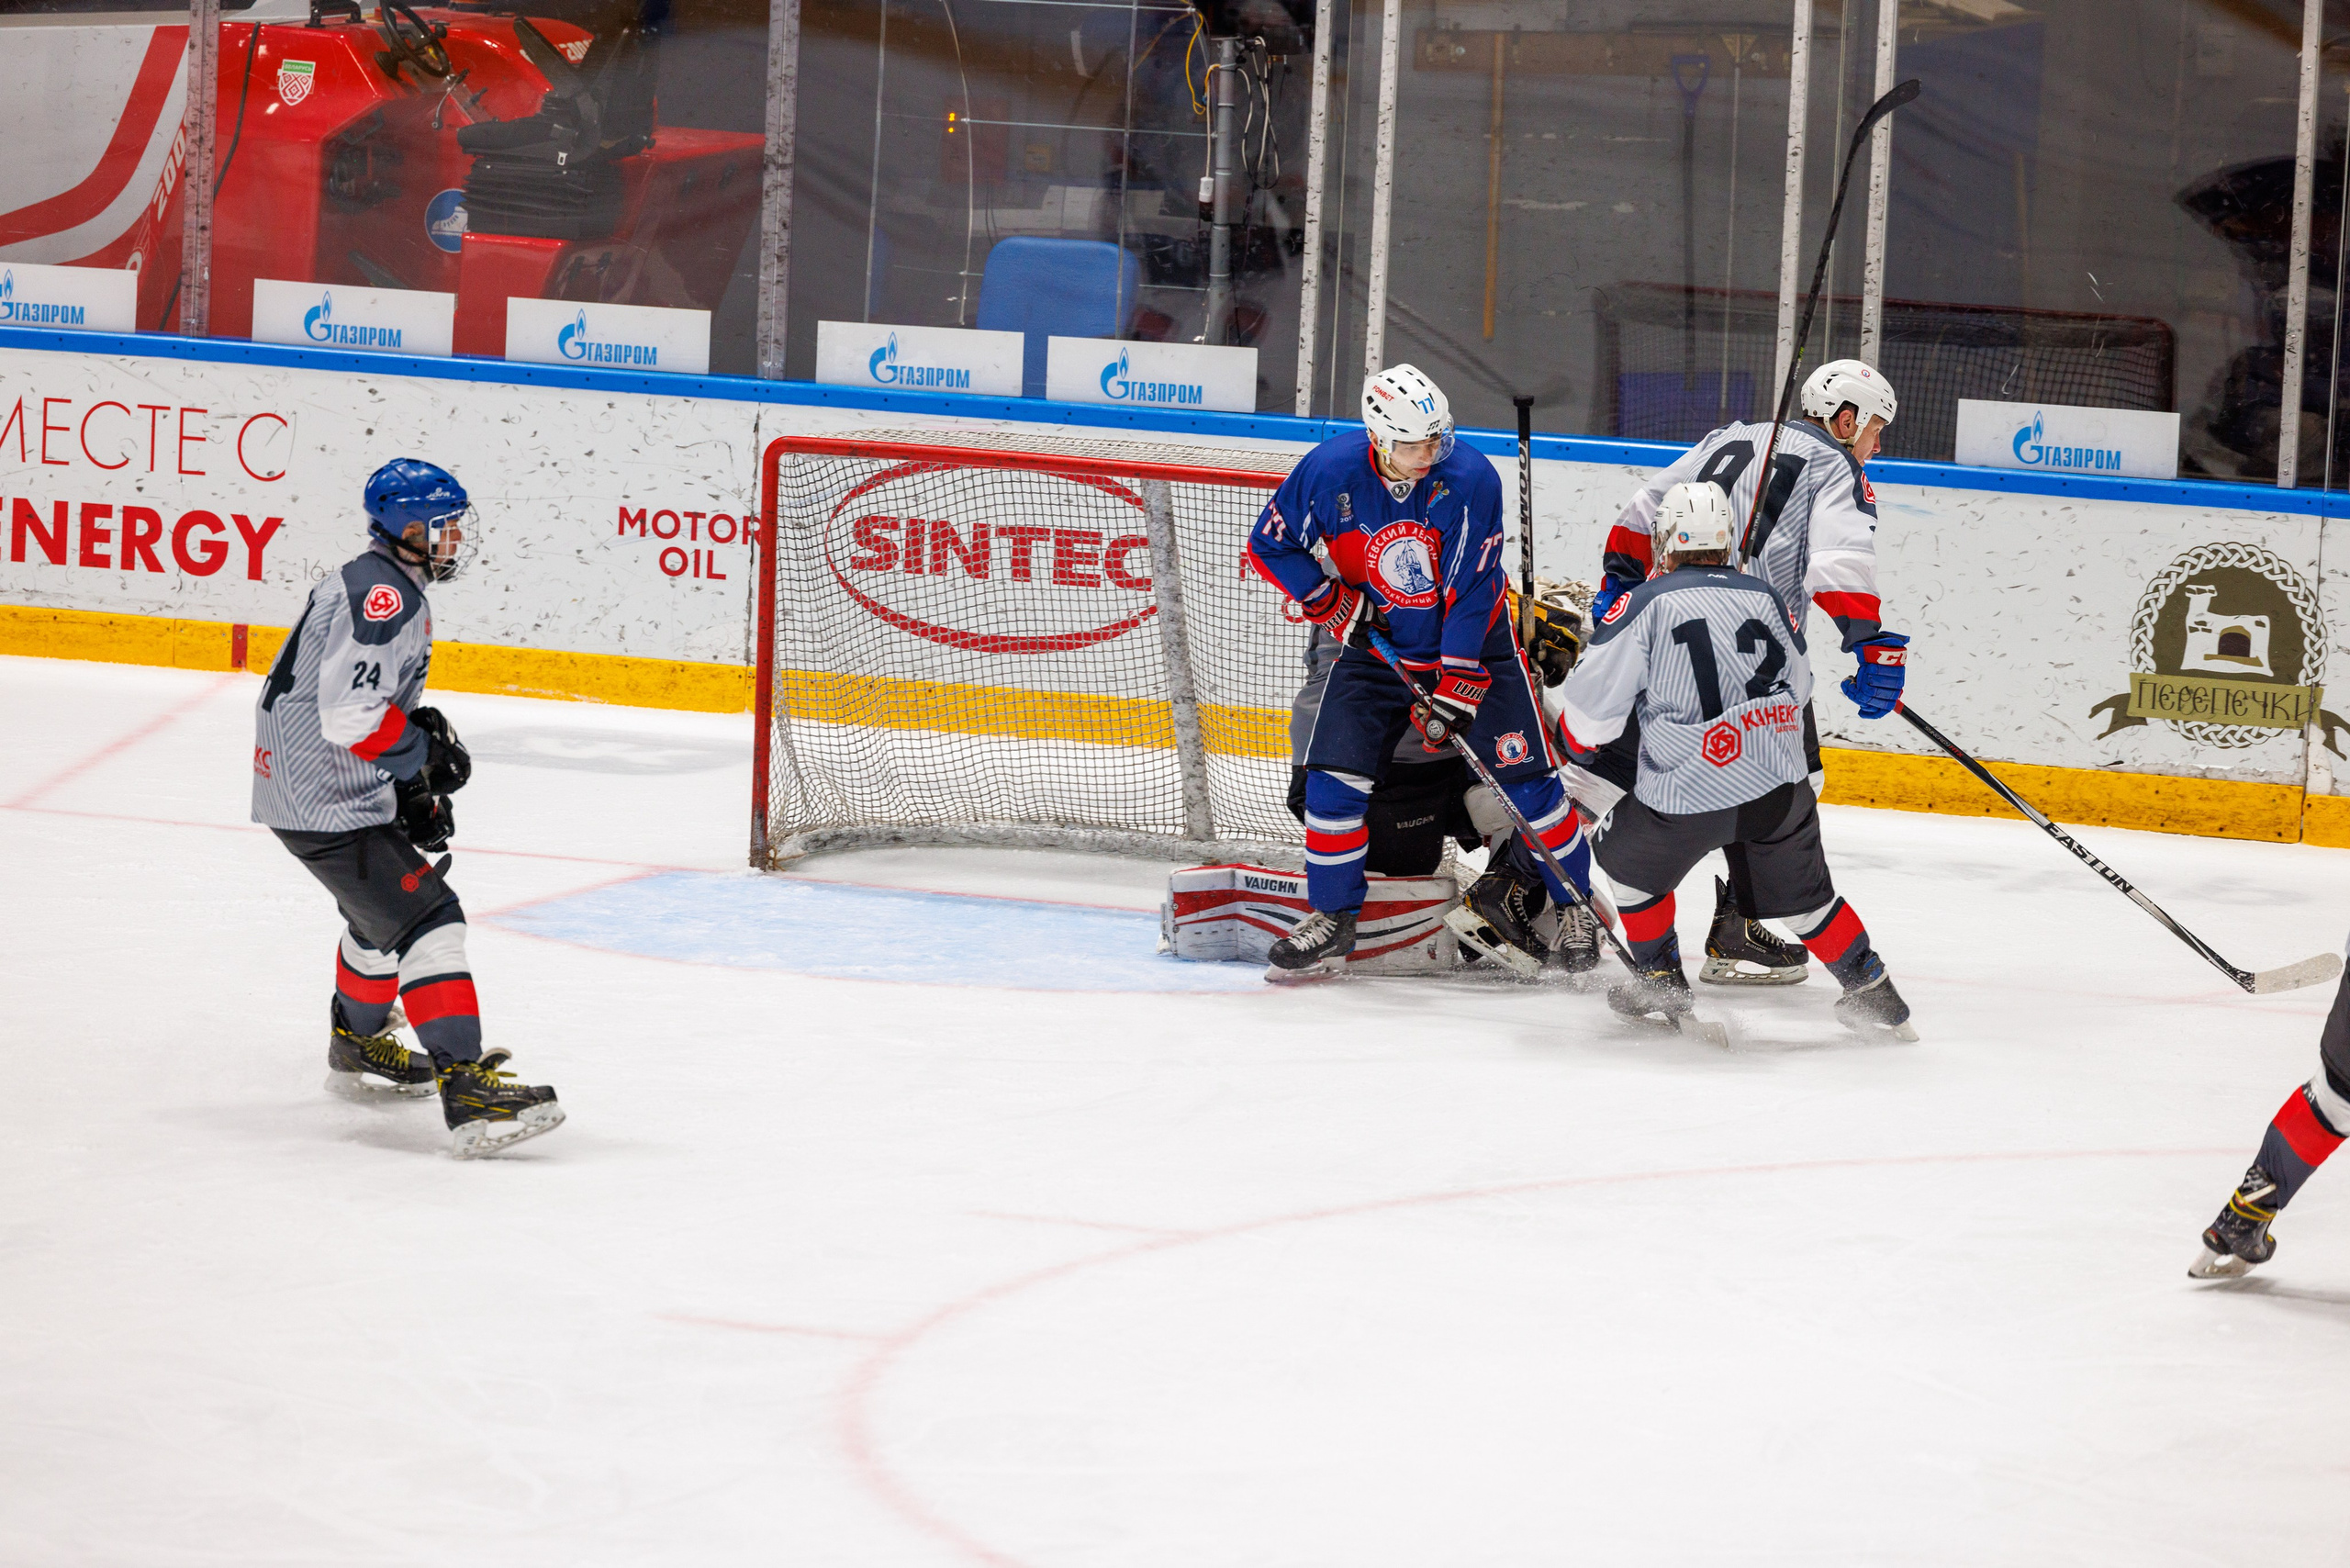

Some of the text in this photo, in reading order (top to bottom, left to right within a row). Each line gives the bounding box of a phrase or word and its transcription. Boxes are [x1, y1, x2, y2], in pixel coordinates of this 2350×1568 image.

[152, 127, 187, 222] 200
[16, 302, 84, 325] ГАЗПРОМ
[333, 324, 402, 348] ГАЗПРОМ
[588, 342, 657, 365] ГАЗПРОМ
[900, 365, 970, 388] ГАЗПРОМ
[1131, 381, 1203, 404] ГАЗПРОМ
[1372, 386, 1394, 401] FONBET
[1417, 398, 1435, 414] 77
[238, 412, 287, 482] С
[2044, 446, 2121, 470] ГАЗПРОМ
[0, 497, 285, 581] NERGY
[618, 507, 761, 545] MOTOR
[850, 515, 1152, 592] SINTEC
[1368, 522, 1406, 568] НЕВСКИЙ
[1412, 528, 1438, 561] ЛЕГОН
[659, 546, 727, 580] OIL
[1322, 592, 1353, 632] RRIOR
[352, 660, 381, 690] 24
[1671, 618, 1790, 722] 12
[1484, 772, 1518, 812] JETSPEED
[1396, 814, 1435, 829] VAUGHN
[2044, 822, 2134, 894] EASTON
[1244, 876, 1298, 894] VAUGHN
